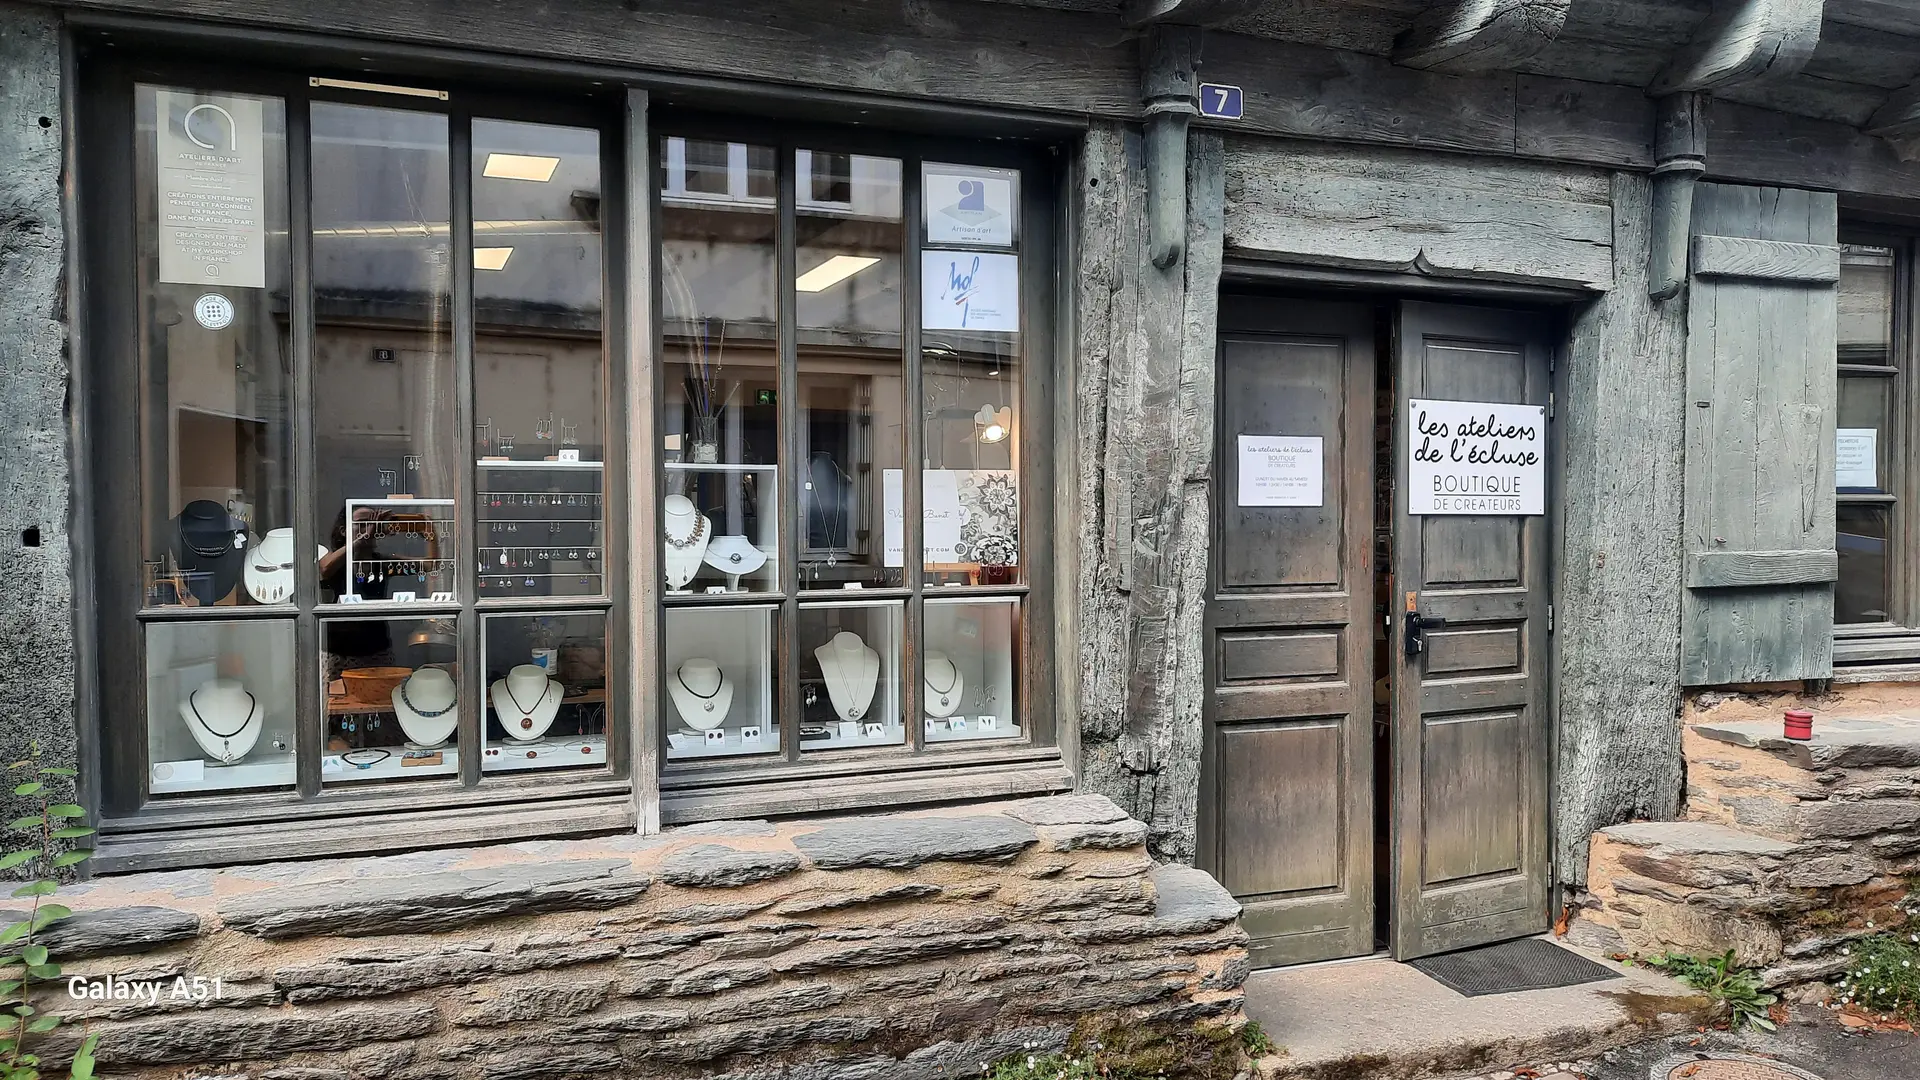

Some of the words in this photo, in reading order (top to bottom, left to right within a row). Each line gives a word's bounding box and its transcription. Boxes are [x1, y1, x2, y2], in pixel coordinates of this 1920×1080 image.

[1214, 89, 1228, 112] 7
[179, 153, 216, 161] ATELIERS
[218, 156, 241, 164] D'ART
[167, 191, 206, 200] CRÉATIONS
[169, 199, 200, 208] PENSÉES
[205, 217, 233, 225] ATELIER
[951, 225, 976, 233] Artisan
[175, 231, 214, 240] CREATIONS
[215, 234, 248, 242] ENTIRELY
[175, 239, 210, 247] DESIGNED
[203, 248, 243, 256] WORKSHOP
[200, 296, 216, 304] MADE
[1418, 411, 1449, 438] les
[1457, 414, 1536, 441] ateliers
[1414, 436, 1444, 463] de
[1450, 438, 1540, 467] l'écluse
[1433, 475, 1521, 493] BOUTIQUE
[1433, 498, 1449, 511] DE
[1454, 498, 1522, 511] CREATEURS
